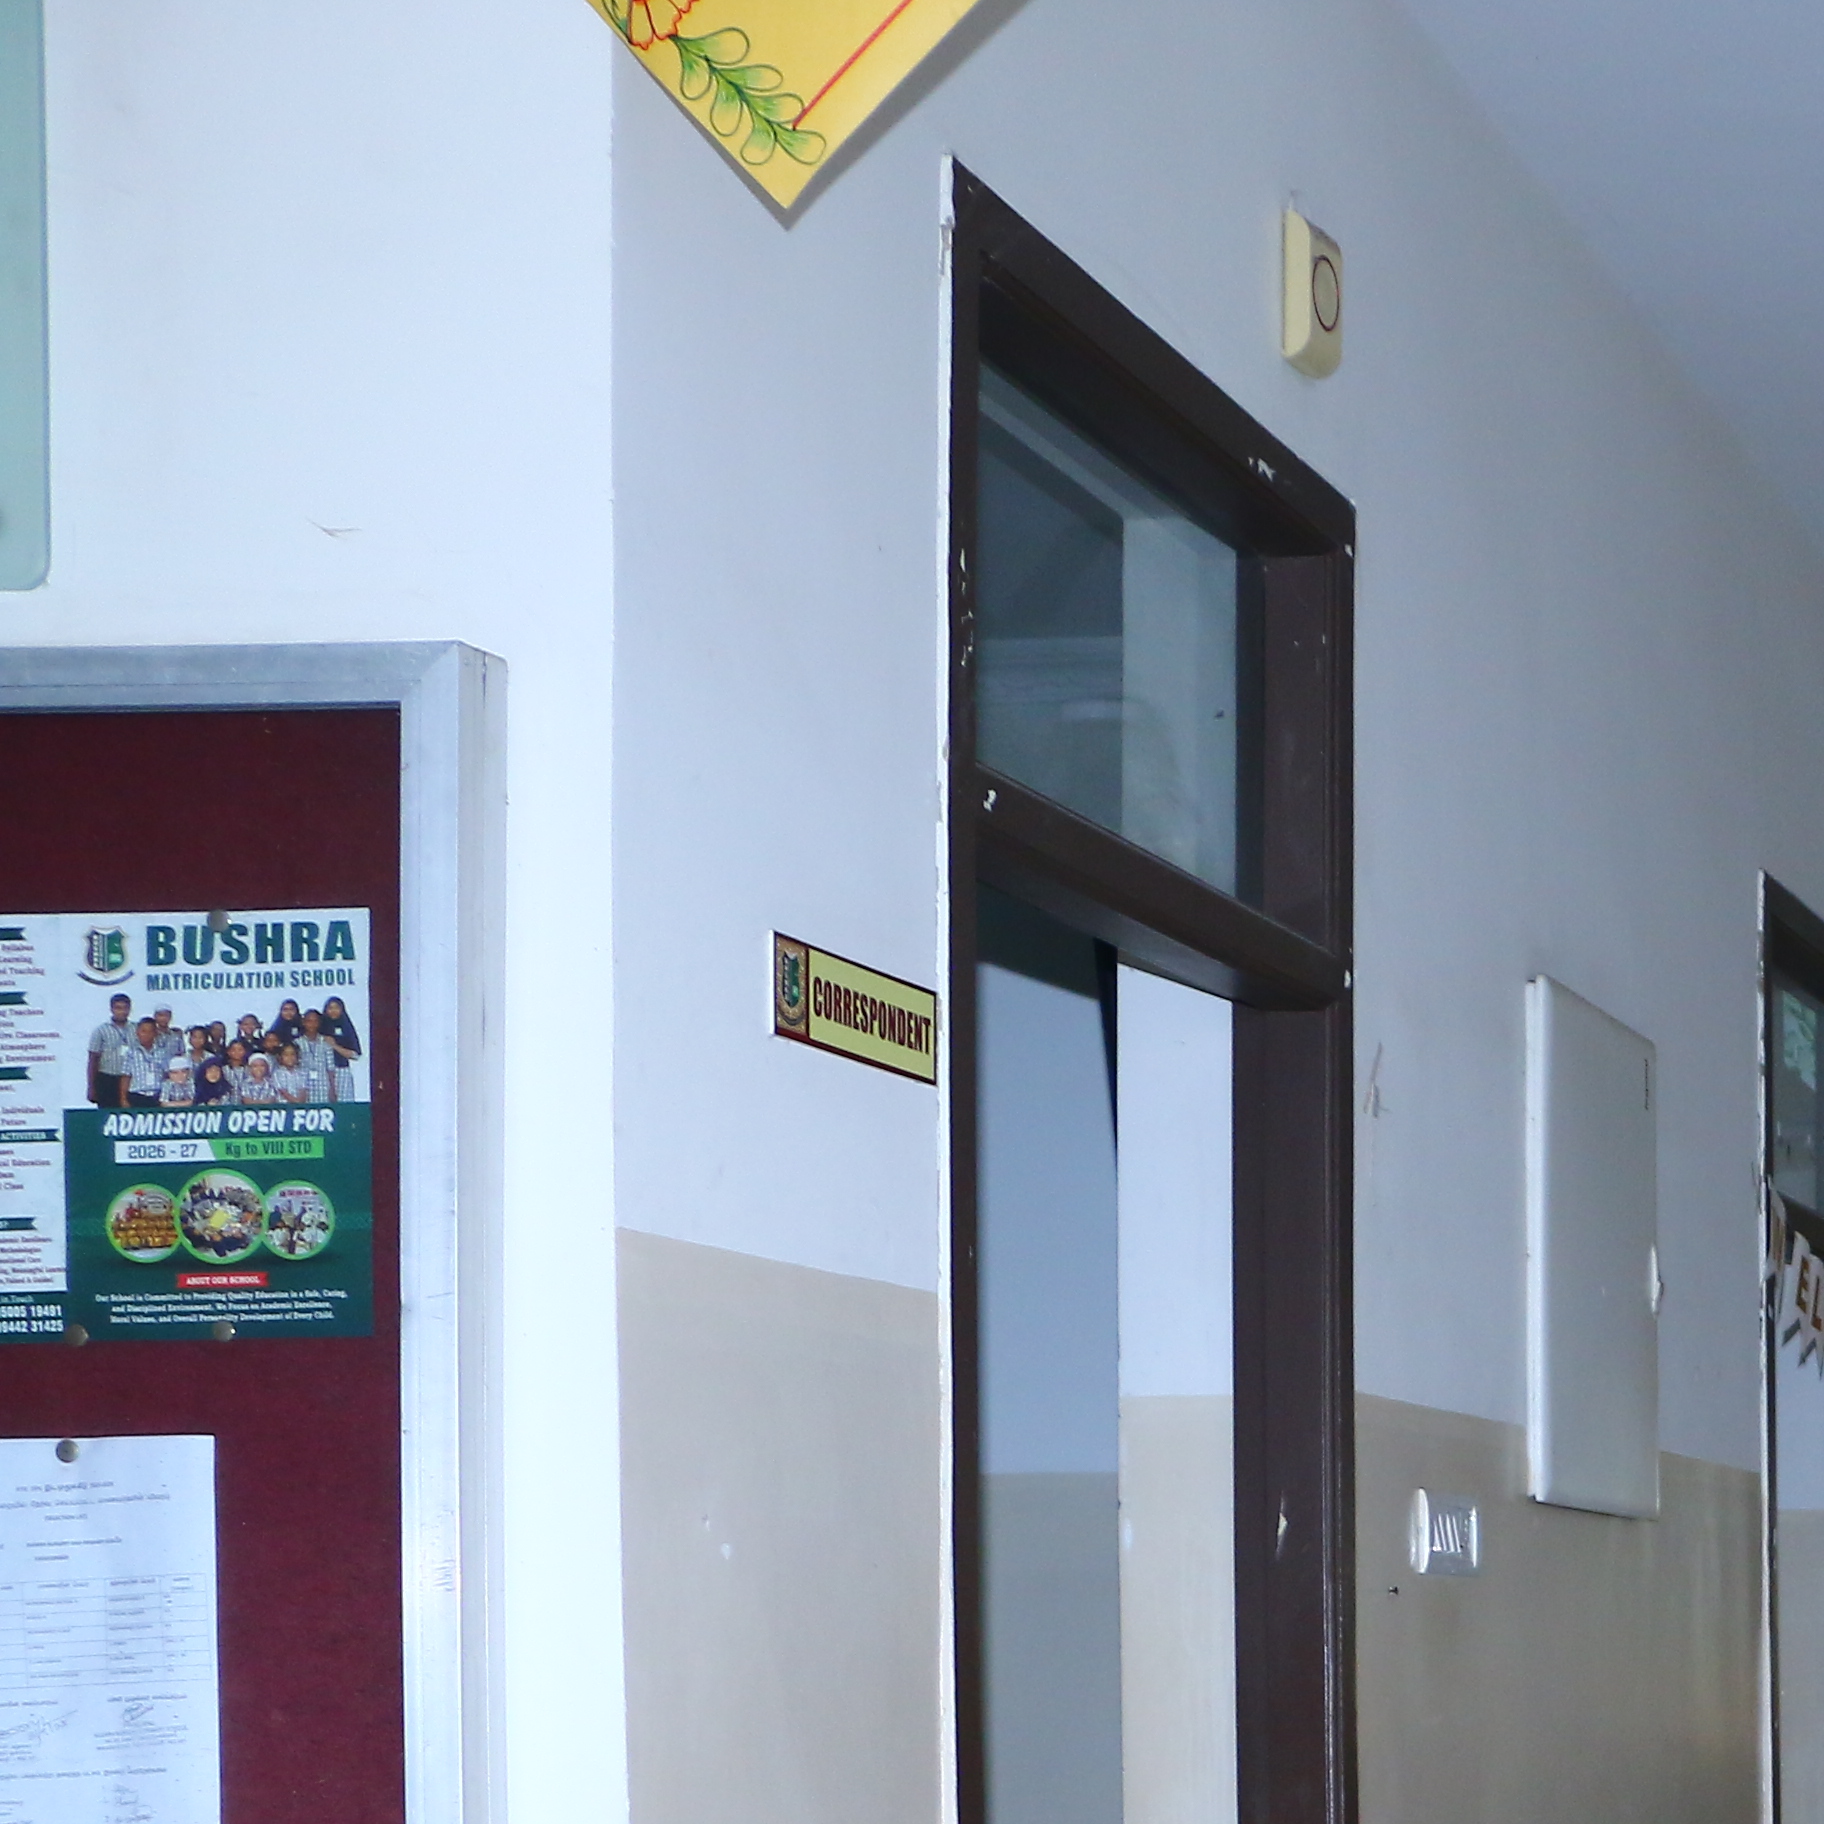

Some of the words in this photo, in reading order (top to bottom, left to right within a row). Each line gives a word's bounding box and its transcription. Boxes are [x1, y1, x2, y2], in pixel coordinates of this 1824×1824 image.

[146, 920, 356, 967] BUSHRA
[146, 971, 285, 991] MATRICULATION
[290, 968, 356, 988] SCHOOL
[813, 975, 932, 1055] CORRESPONDENT
[103, 1111, 222, 1137] ADMISSION
[228, 1109, 287, 1134] OPEN
[292, 1107, 335, 1133] FOR
[127, 1144, 166, 1160] 2026
[180, 1143, 198, 1158] 27
[246, 1141, 258, 1155] to
[288, 1140, 312, 1154] STD
[30, 1319, 64, 1333] 31425
